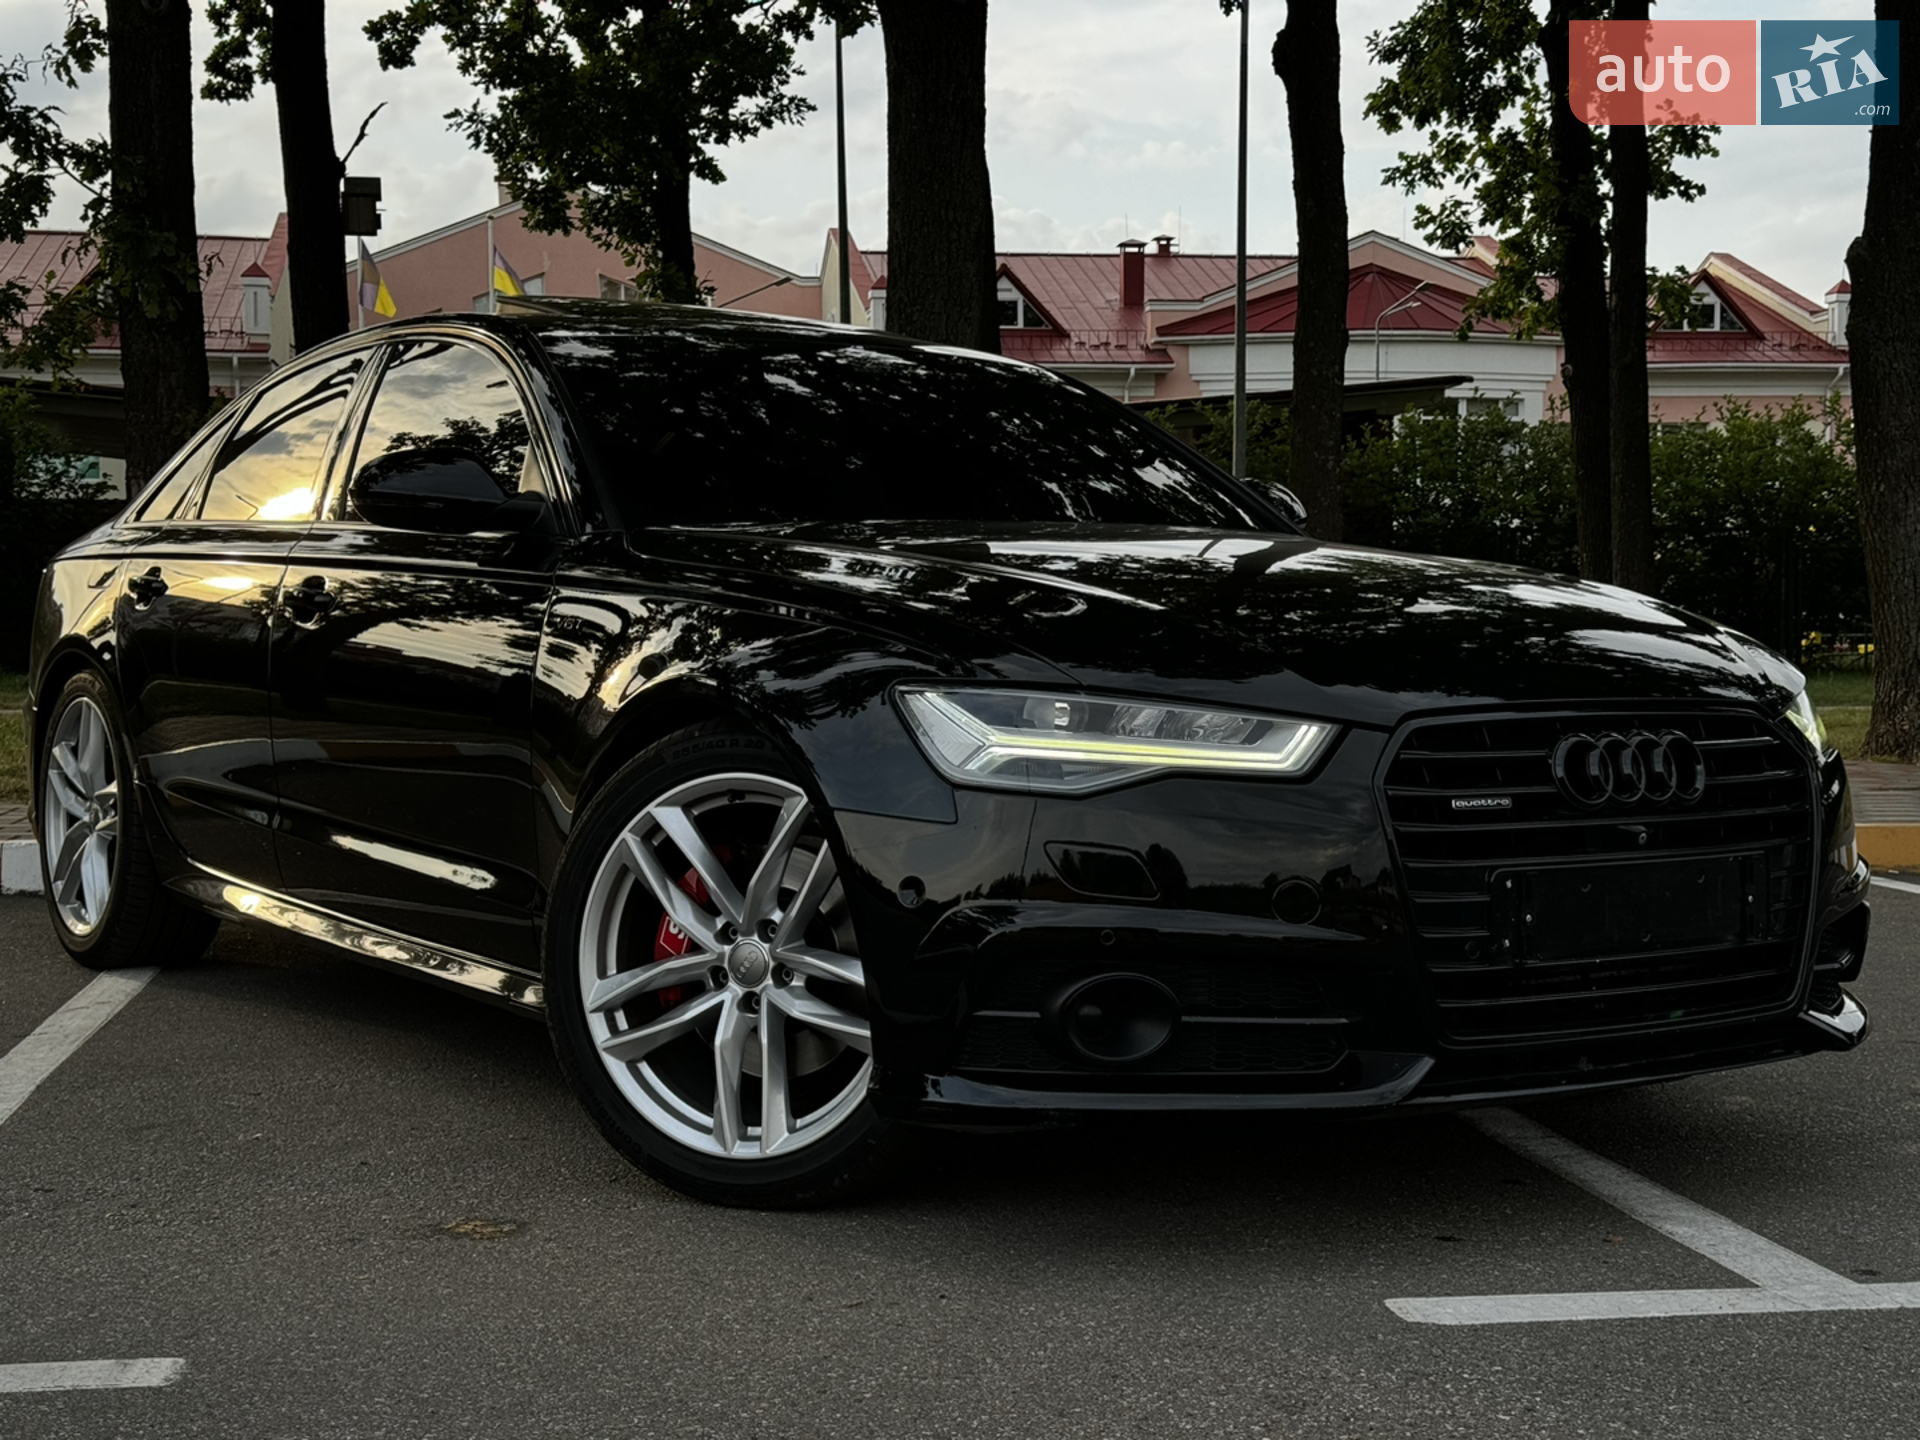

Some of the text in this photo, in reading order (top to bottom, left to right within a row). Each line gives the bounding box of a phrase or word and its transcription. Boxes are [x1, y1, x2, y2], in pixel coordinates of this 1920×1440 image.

[556, 616, 583, 630] V6T
[672, 738, 726, 761] 255/40
[729, 738, 740, 749] R
[743, 738, 765, 750] 20
[1454, 798, 1510, 808] quattro
